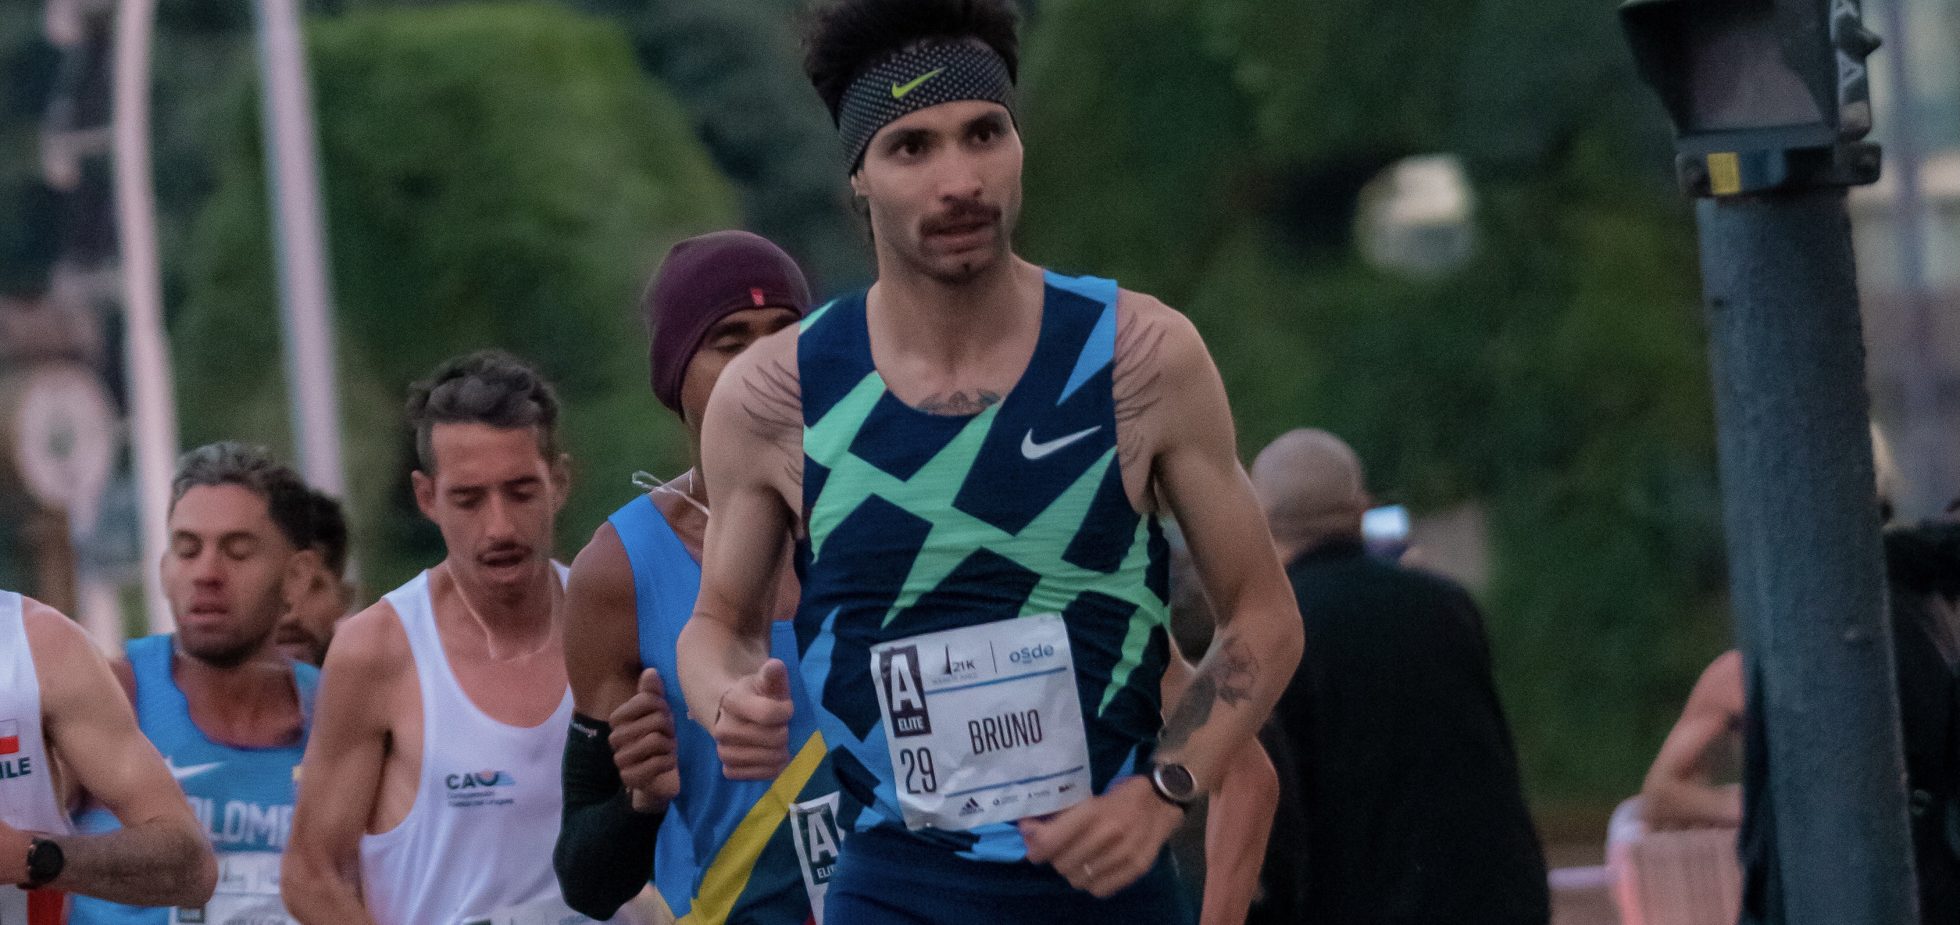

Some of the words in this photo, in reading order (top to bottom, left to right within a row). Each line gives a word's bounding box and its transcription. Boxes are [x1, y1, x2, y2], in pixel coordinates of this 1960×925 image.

[952, 660, 976, 672] 21K
[1009, 644, 1054, 664] osde
[890, 653, 924, 712] A
[898, 716, 924, 732] ELITE
[968, 708, 1043, 755] BRUNO
[445, 771, 500, 790] CAU
[900, 747, 937, 795] 29
[807, 813, 839, 863] A
